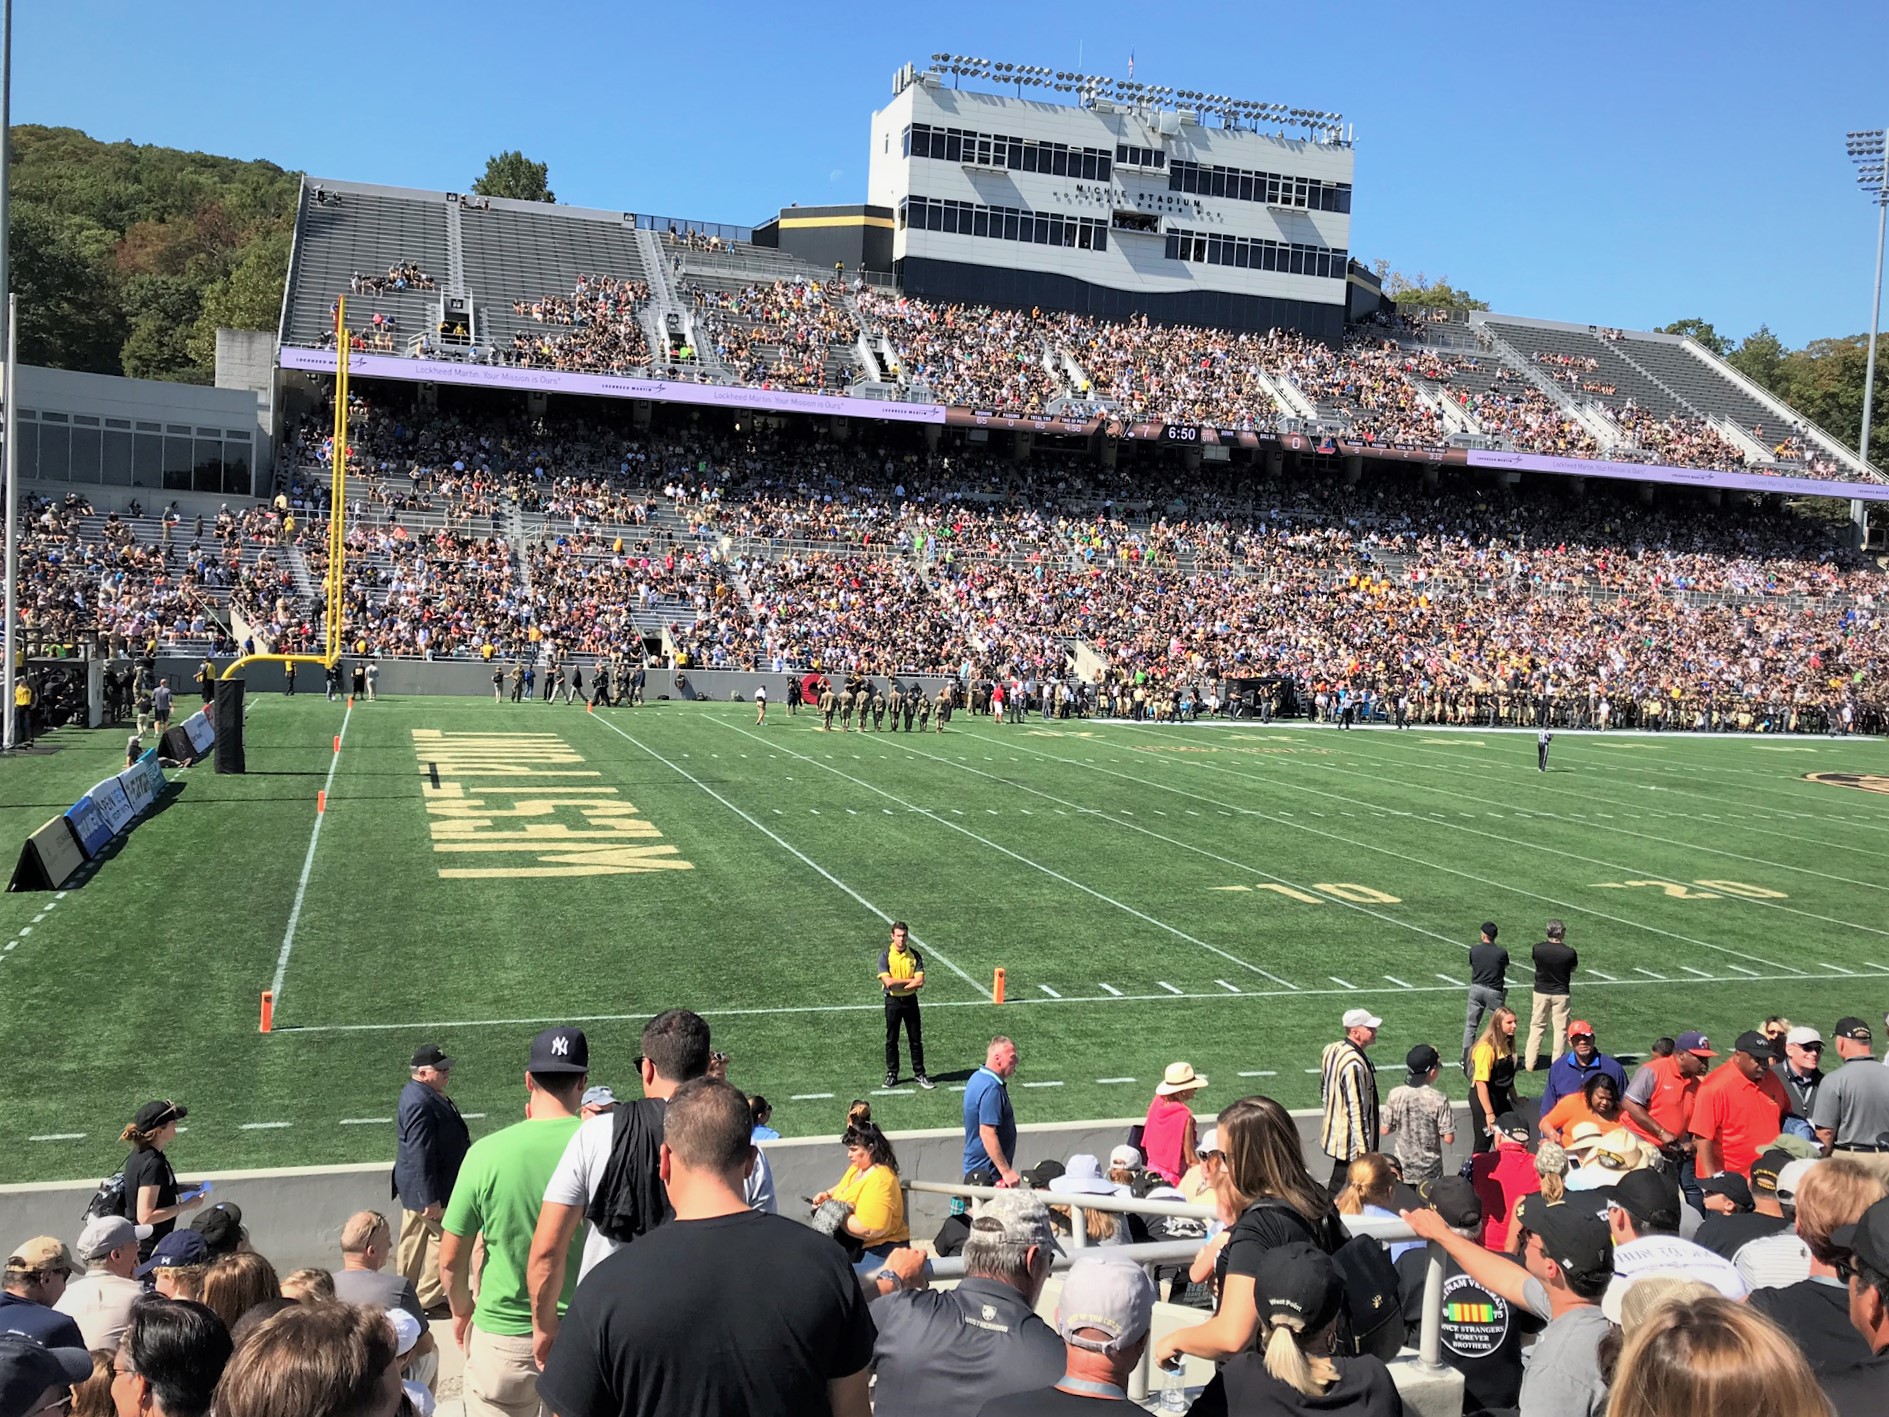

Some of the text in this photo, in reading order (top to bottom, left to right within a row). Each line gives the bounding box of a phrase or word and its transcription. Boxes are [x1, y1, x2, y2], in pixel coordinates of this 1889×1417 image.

[1076, 184, 1200, 207] MICHIE STADIUM
[1053, 191, 1221, 218] HOFFMAN PRESS BOX
[415, 365, 453, 376] Lockheed
[483, 371, 499, 380] Your
[501, 373, 530, 383] Mission
[714, 391, 747, 400] Lockheed
[774, 397, 789, 405] Your
[791, 399, 817, 407] Mission
[976, 416, 988, 425] 65
[1008, 419, 1014, 427] 0
[1034, 421, 1046, 430] 65
[1142, 425, 1151, 438] 7
[1168, 427, 1196, 440] 6:50
[1292, 437, 1301, 449] 0
[1403, 450, 1409, 458] 2
[1552, 461, 1577, 470] Lockheed
[1255, 883, 1402, 905] 10
[1623, 879, 1790, 900] 20
[551, 1036, 569, 1056] NY
[1268, 1298, 1303, 1313] West Point
[1493, 1310, 1504, 1320] 75
[1460, 1325, 1505, 1334] STRANGERS
[1454, 1333, 1490, 1342] FOREVER
[1452, 1341, 1492, 1350] BROTHERS
